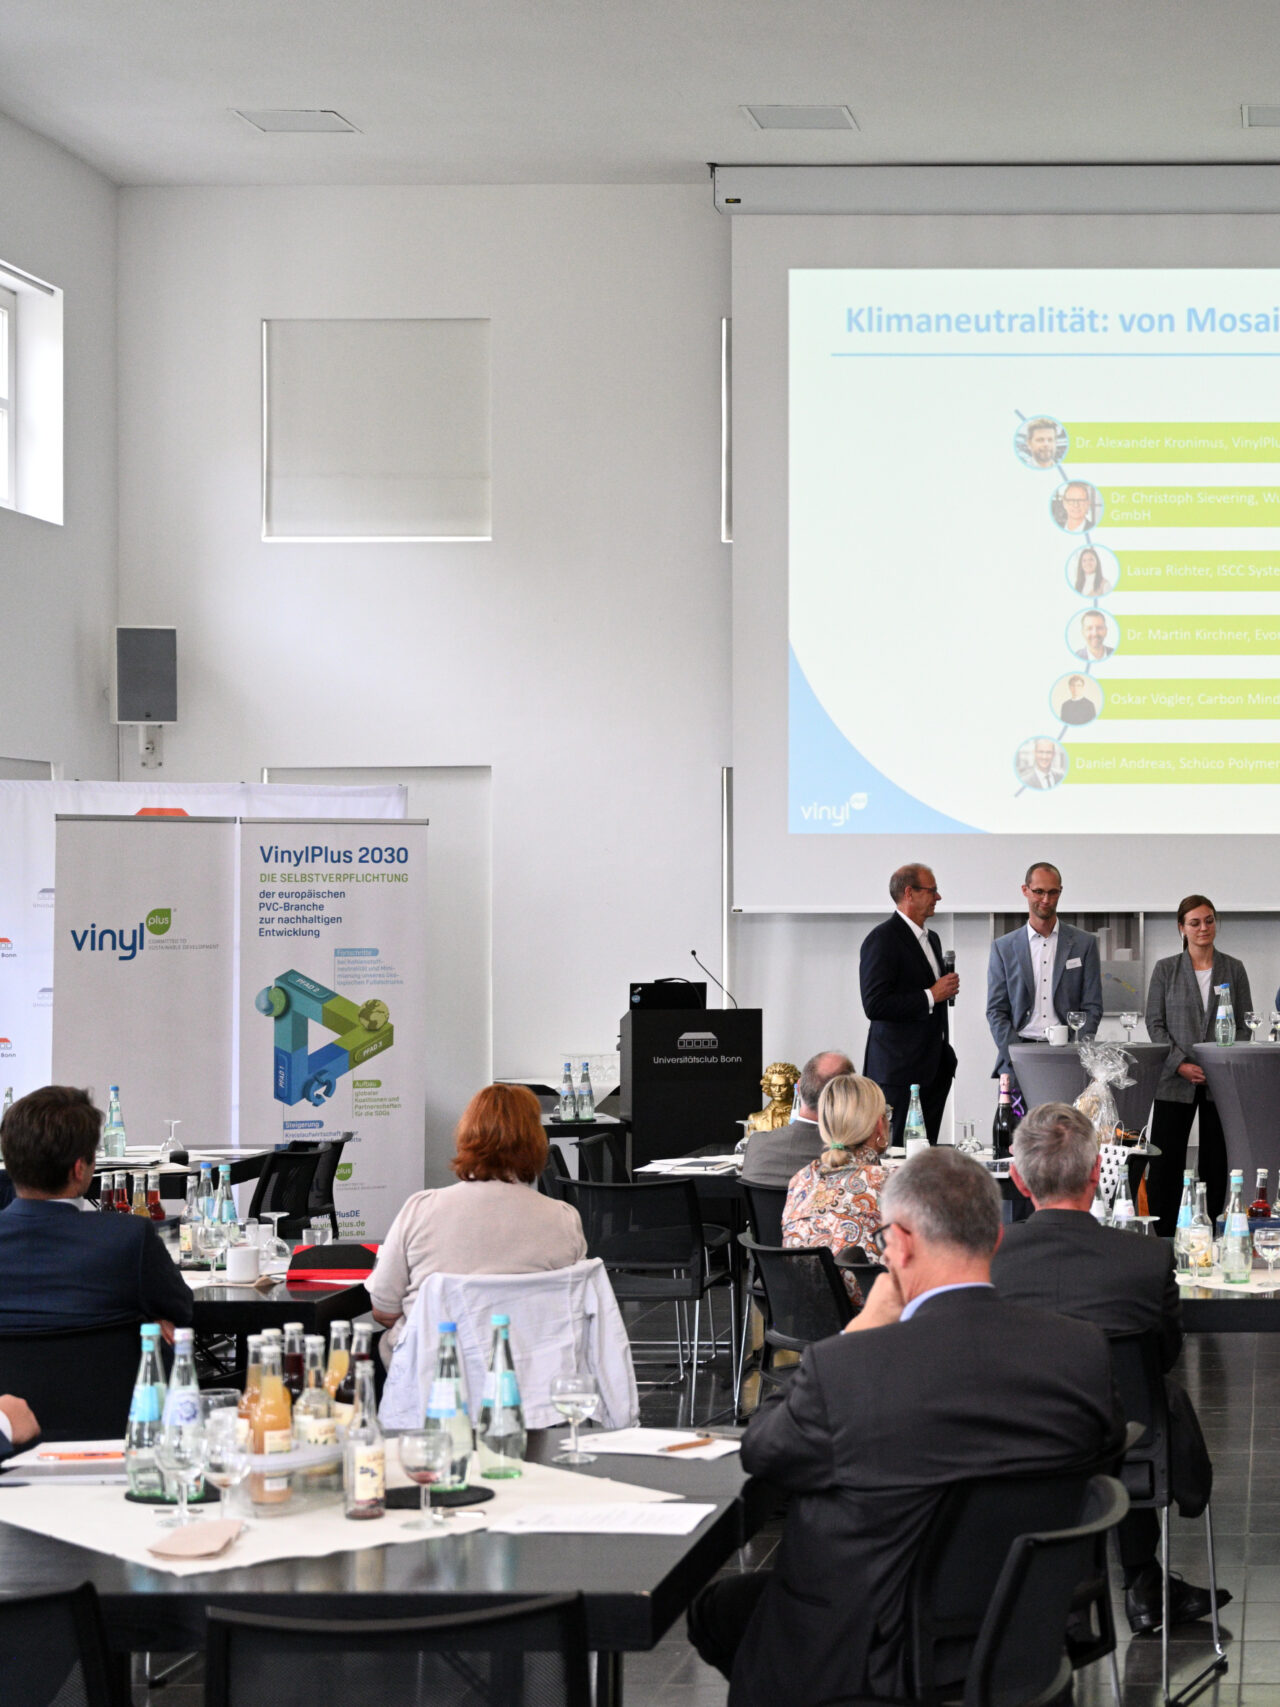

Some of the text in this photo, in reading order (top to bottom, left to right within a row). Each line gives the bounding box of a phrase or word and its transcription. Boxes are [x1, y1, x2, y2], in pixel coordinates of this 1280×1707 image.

[845, 305, 1108, 334] Klimaneutralität:
[1118, 312, 1176, 333] von
[1075, 435, 1094, 449] Dr.
[1096, 435, 1160, 449] Alexander
[1164, 436, 1229, 451] Kronimus,
[1110, 491, 1129, 504] Dr.
[1131, 491, 1193, 507] Christoph
[1196, 491, 1259, 507] Sievering,
[1110, 509, 1152, 522] GmbH
[1126, 563, 1162, 577] Laura
[1165, 563, 1213, 579] Richter,
[1217, 563, 1245, 577] ISCC
[1126, 627, 1146, 641] Dr.
[1148, 627, 1192, 641] Martin
[1194, 627, 1251, 643] Kirchner,
[1110, 692, 1147, 705] Oskar
[1197, 692, 1244, 705] Carbon
[1075, 756, 1117, 770] Daniel
[1119, 756, 1177, 773] Andreas,
[1179, 756, 1225, 770] Schüco
[1227, 756, 1280, 773] Polymer
[800, 801, 850, 828] vinyl
[259, 845, 409, 867] VinylPlus 2030
[259, 872, 409, 883] DIE SELBSTVERPFLICHTUNG
[258, 889, 346, 901] der europäischen
[258, 902, 325, 912] PVC-Branche
[258, 914, 343, 926] zur nachhaltigen
[70, 916, 169, 962] vinyl plus
[258, 927, 320, 939] Entwicklung
[653, 1055, 742, 1064] Universitätsclub Bonn
